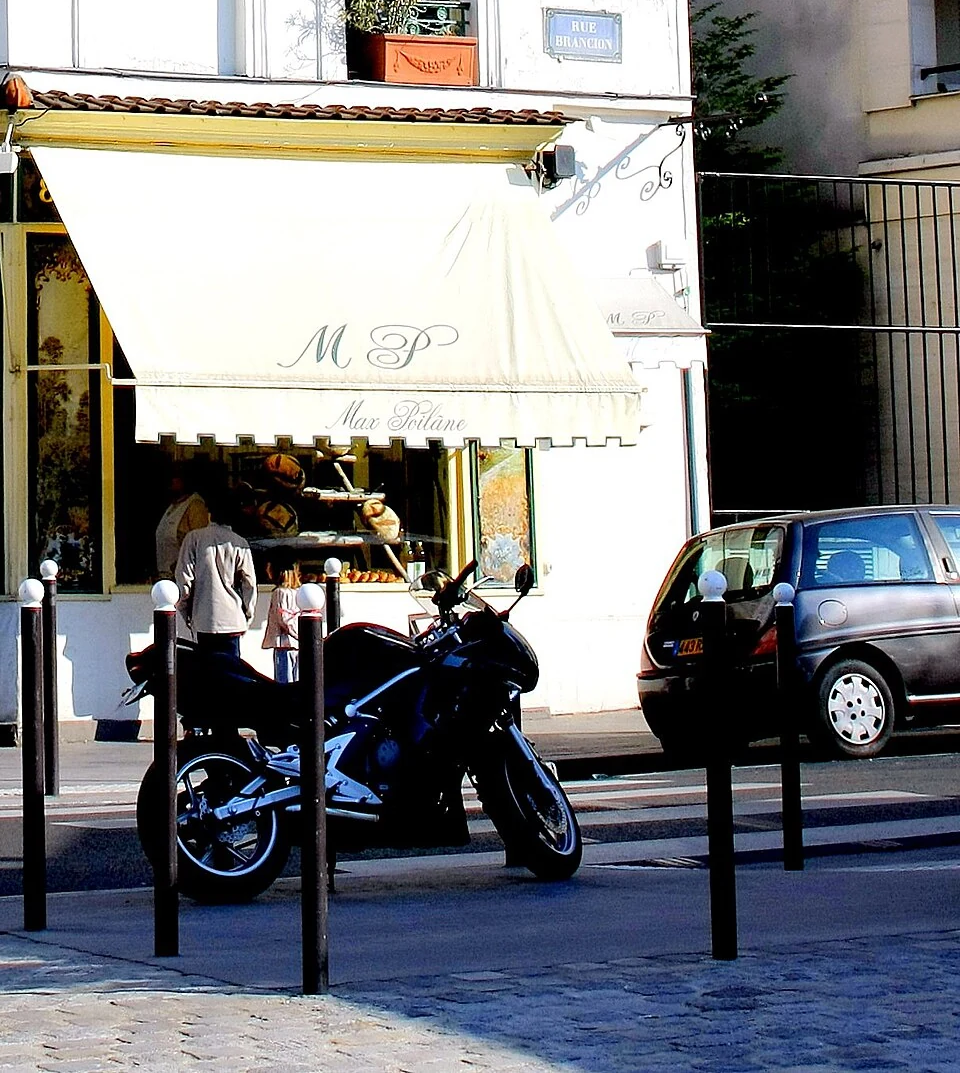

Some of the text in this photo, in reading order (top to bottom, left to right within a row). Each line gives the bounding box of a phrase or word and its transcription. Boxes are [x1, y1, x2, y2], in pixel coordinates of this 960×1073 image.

[571, 20, 597, 34] RUE
[555, 35, 613, 50] BRANCION
[276, 323, 460, 370] M P
[325, 399, 469, 432] Max Poilâne
